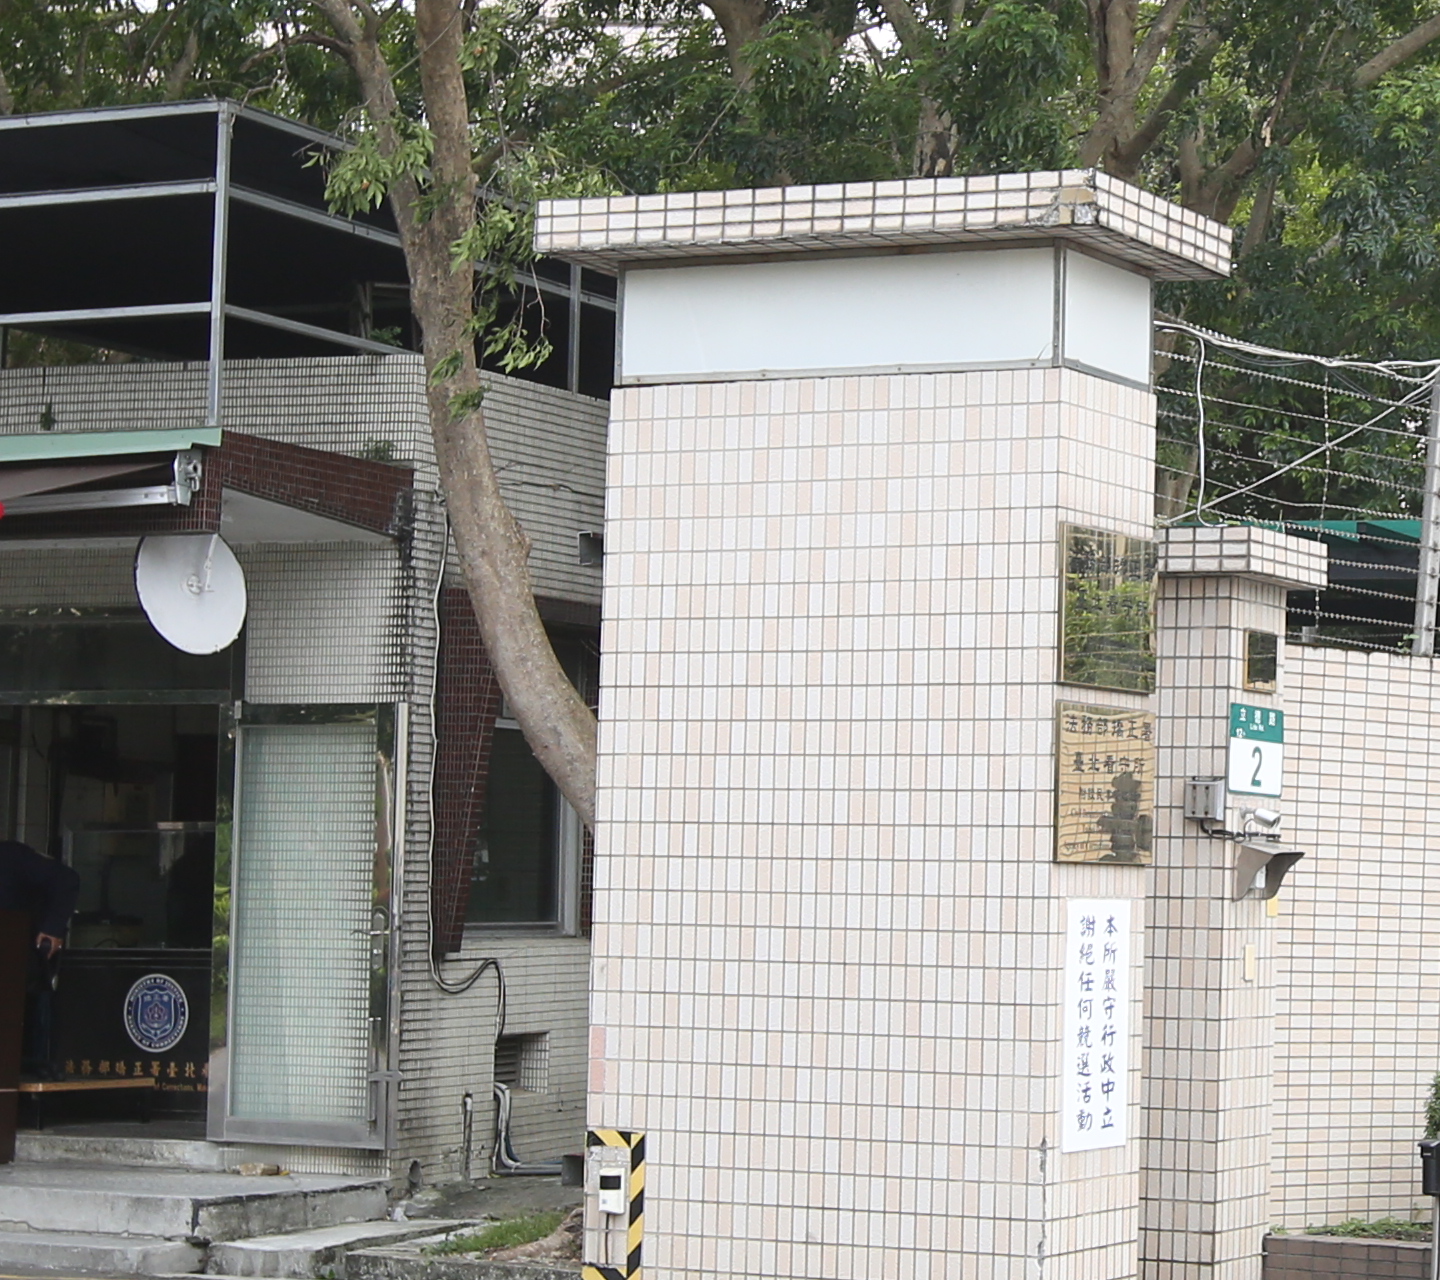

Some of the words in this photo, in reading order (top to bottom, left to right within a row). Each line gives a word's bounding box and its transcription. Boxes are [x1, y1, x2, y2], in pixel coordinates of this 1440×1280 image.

[1072, 751, 1145, 775] 臺北看守所
[1250, 746, 1263, 787] 2
